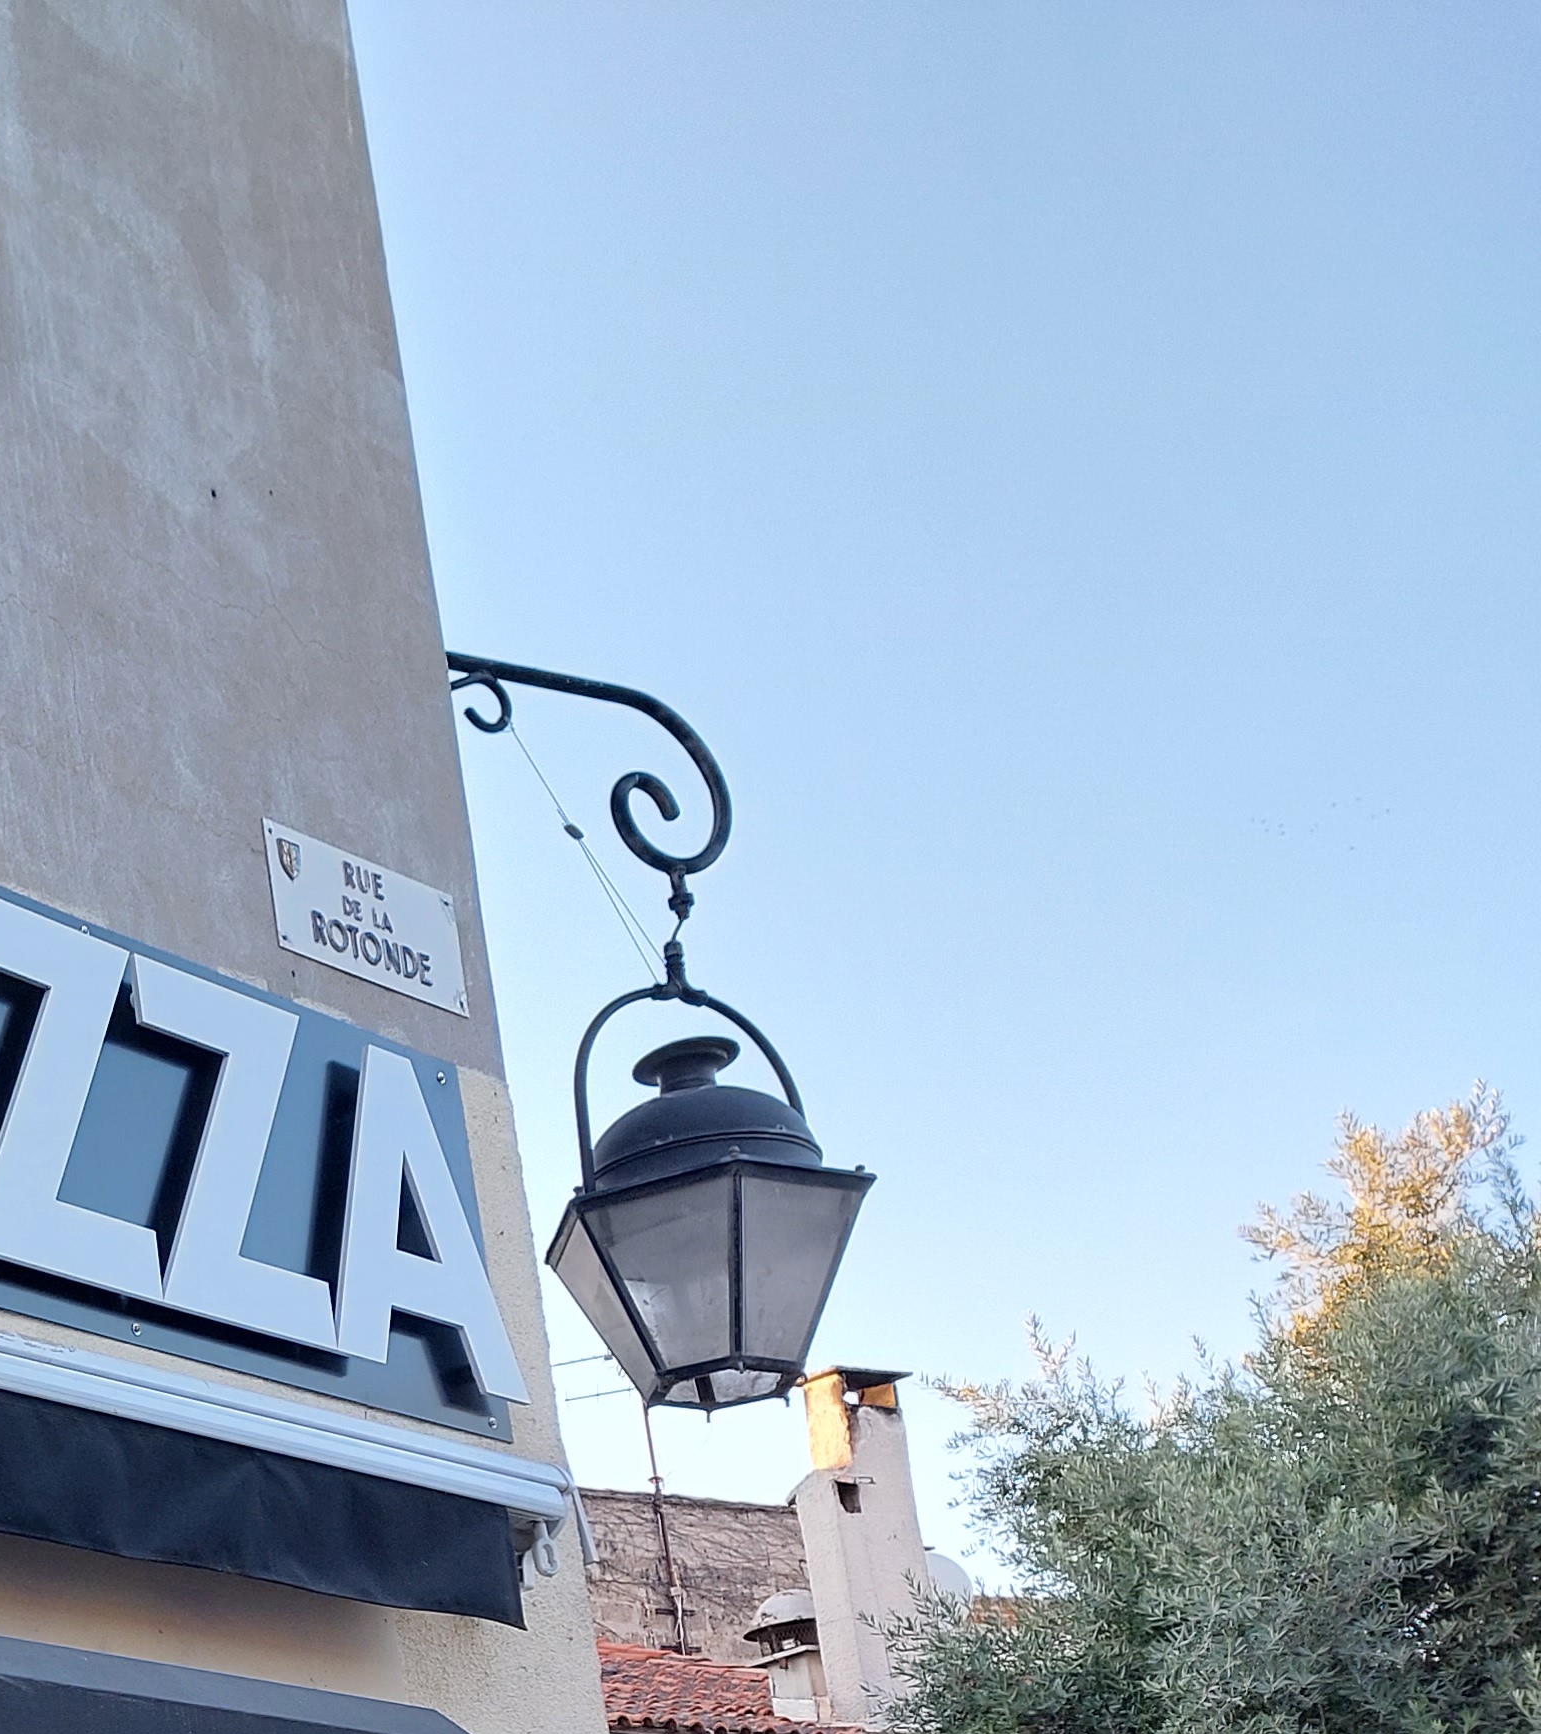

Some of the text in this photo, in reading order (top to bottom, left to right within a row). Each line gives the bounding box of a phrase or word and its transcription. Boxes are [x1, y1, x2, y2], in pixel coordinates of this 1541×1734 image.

[342, 860, 384, 901] RUE
[342, 895, 393, 934] DE LA
[311, 910, 433, 987] ROTONDE
